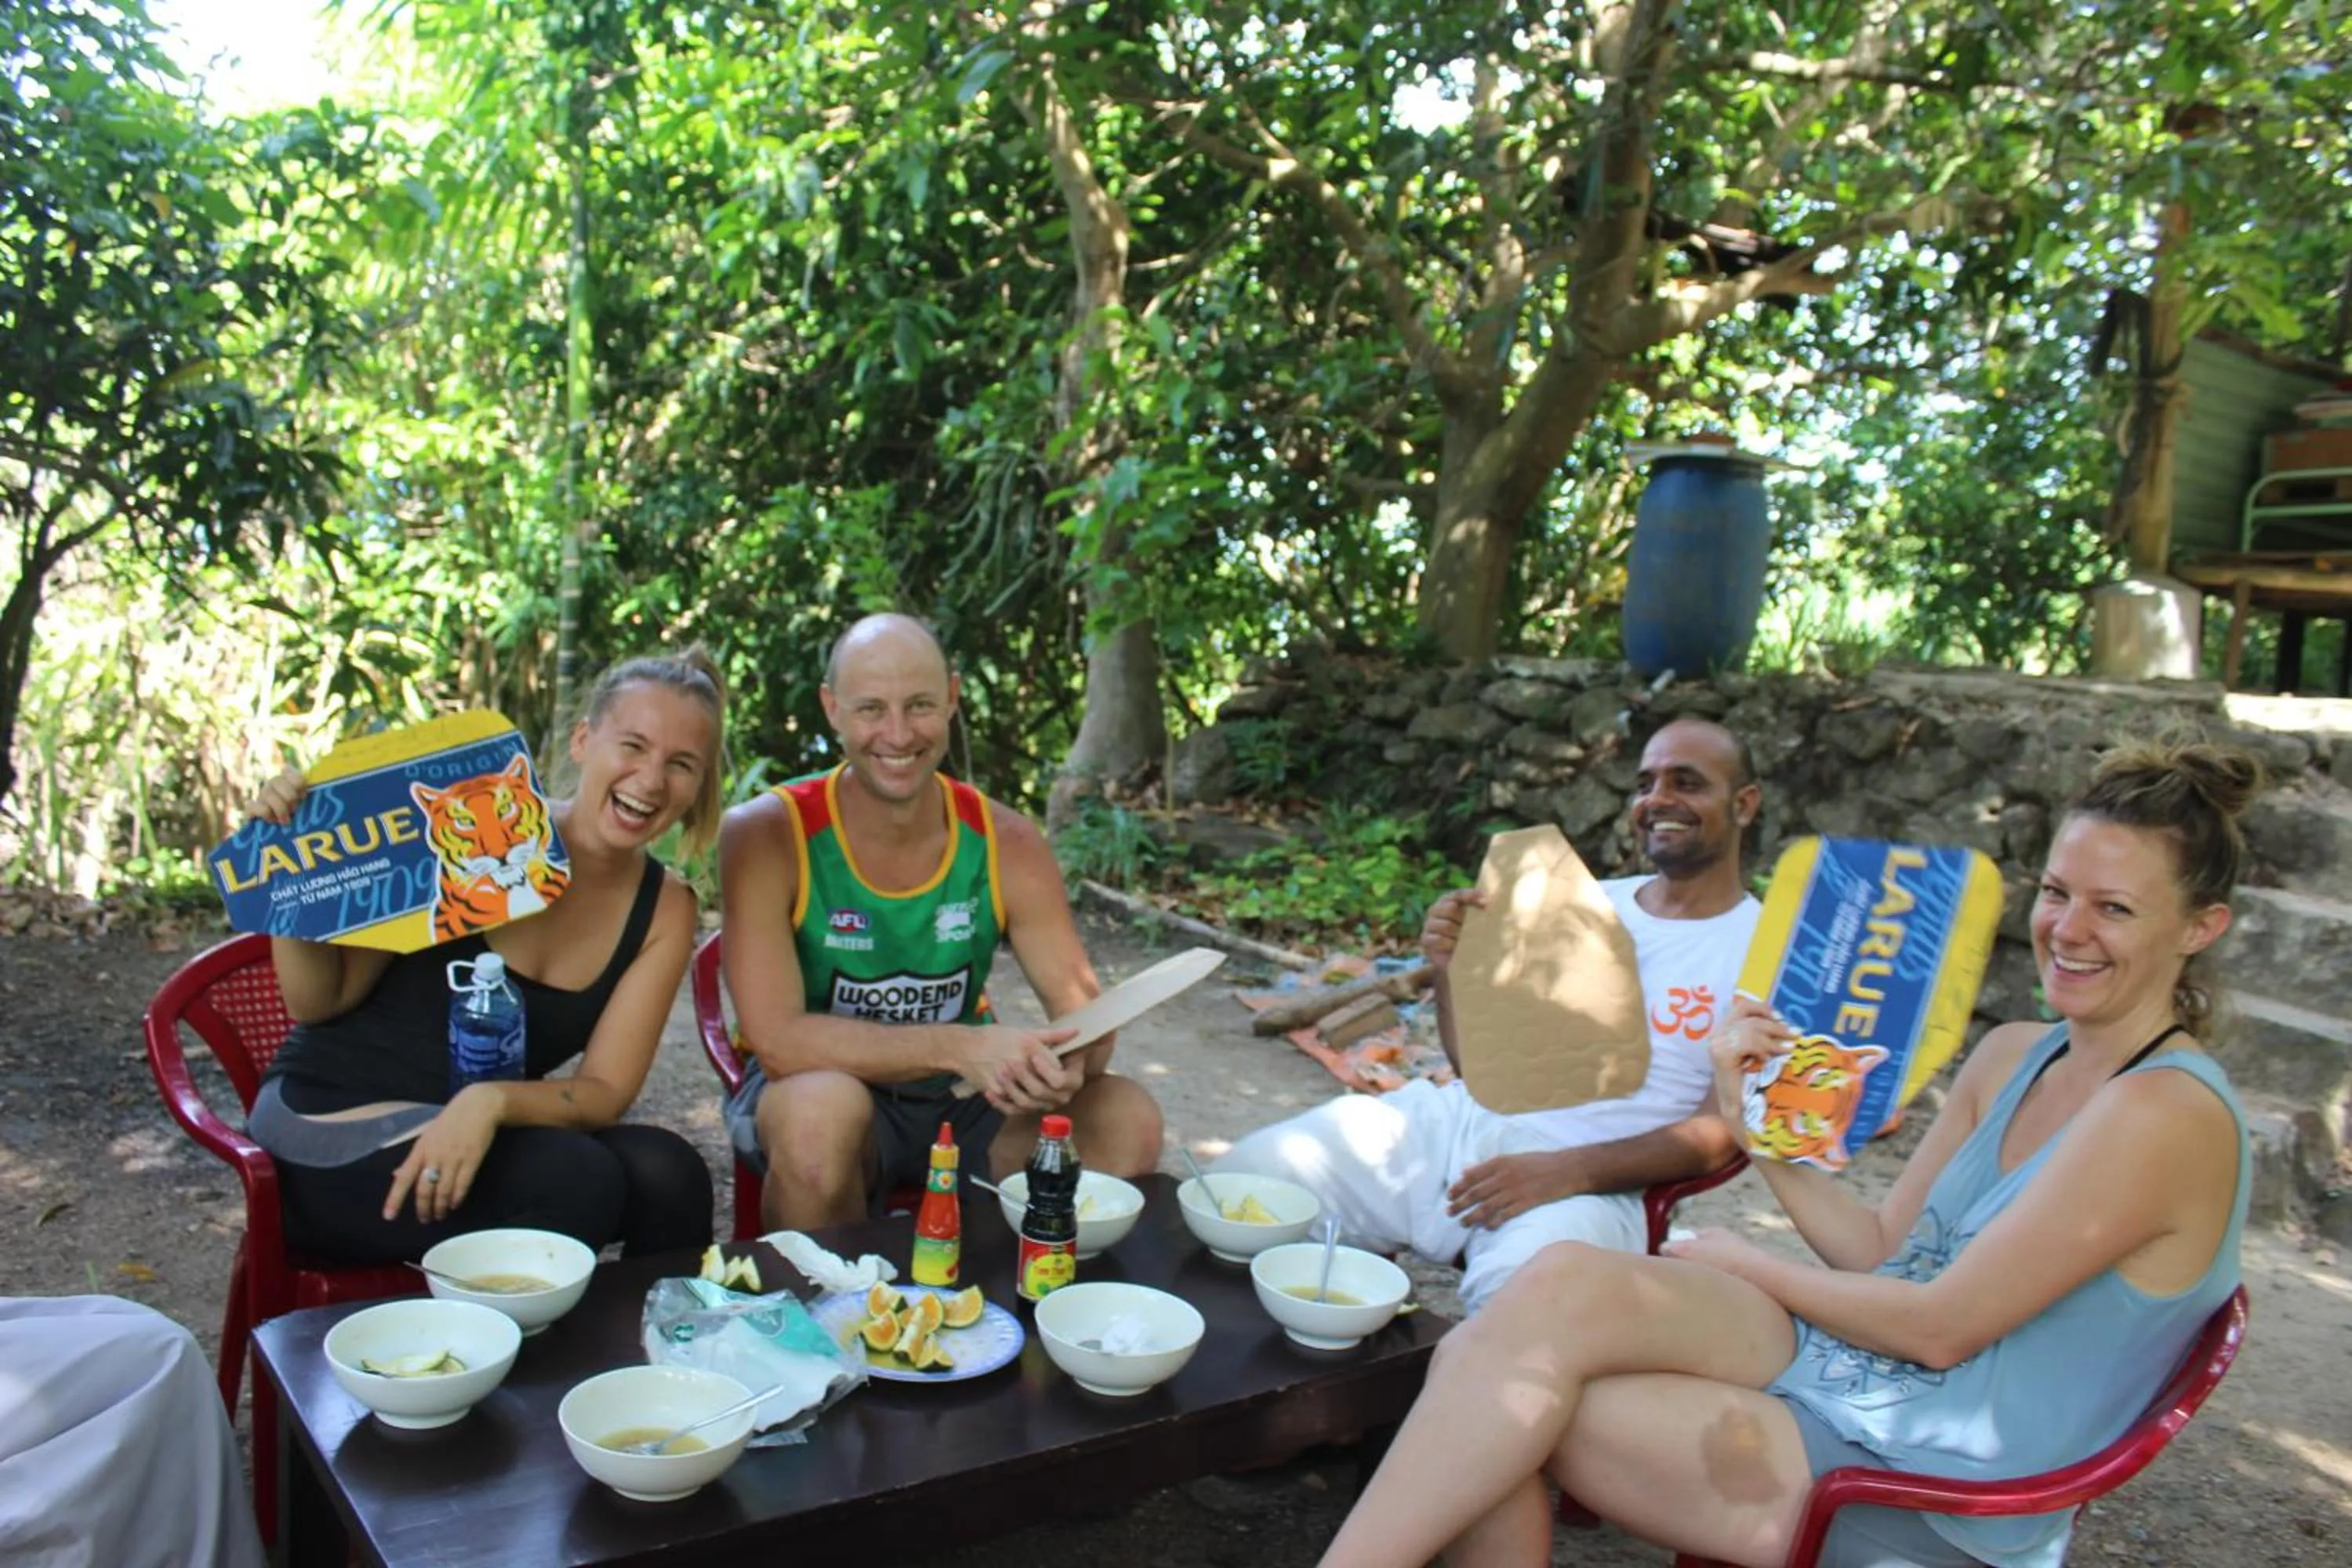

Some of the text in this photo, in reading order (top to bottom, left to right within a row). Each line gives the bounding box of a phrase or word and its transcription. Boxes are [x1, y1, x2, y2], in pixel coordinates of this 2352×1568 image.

[215, 806, 419, 894] LARUE
[829, 913, 866, 930] AFL
[1832, 845, 1928, 1037] LARUE
[839, 981, 963, 1007] WOODEND
